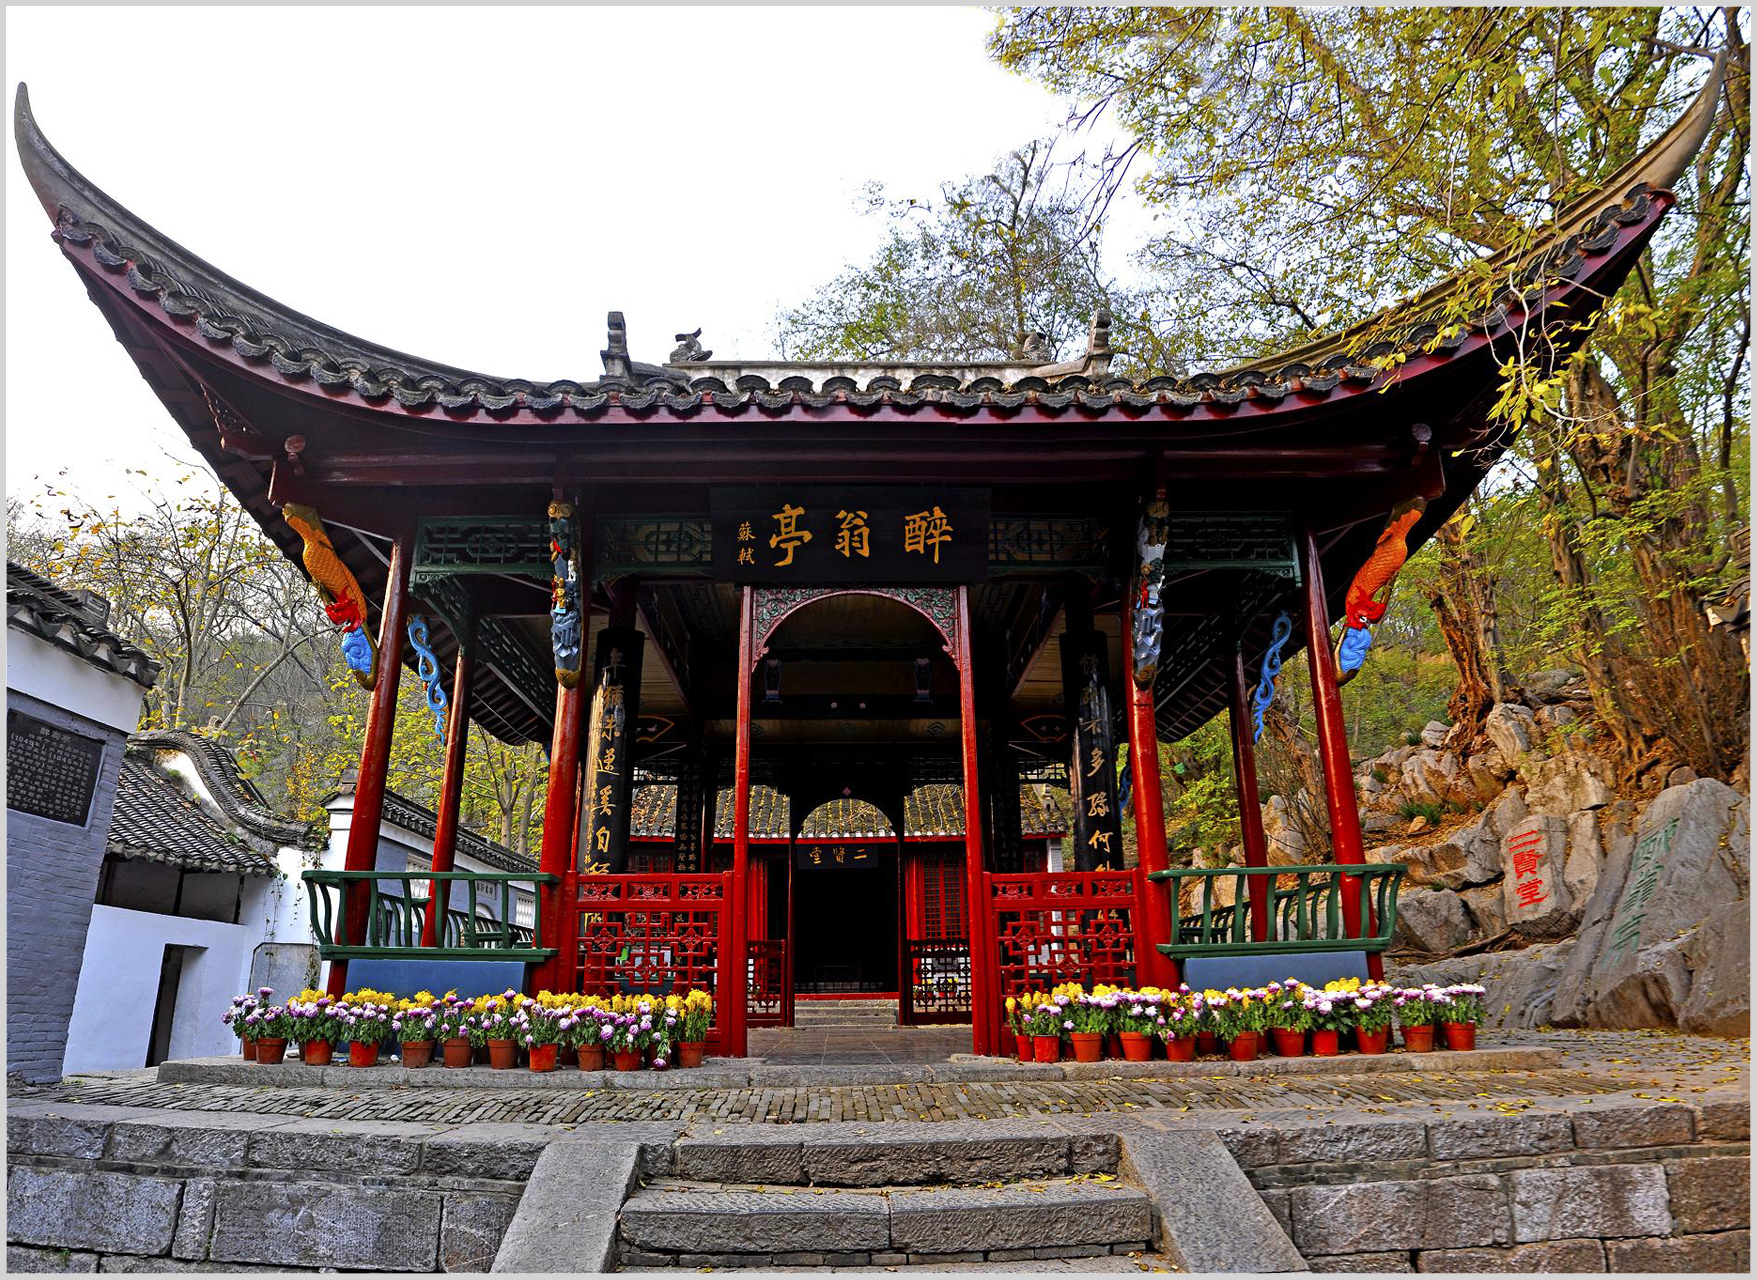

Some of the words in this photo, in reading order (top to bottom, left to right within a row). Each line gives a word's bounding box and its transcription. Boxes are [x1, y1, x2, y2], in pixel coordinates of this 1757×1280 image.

[737, 521, 756, 566] 蘇軾
[769, 503, 954, 567] 醉翁亭
[1507, 829, 1549, 908] 二賢堂
